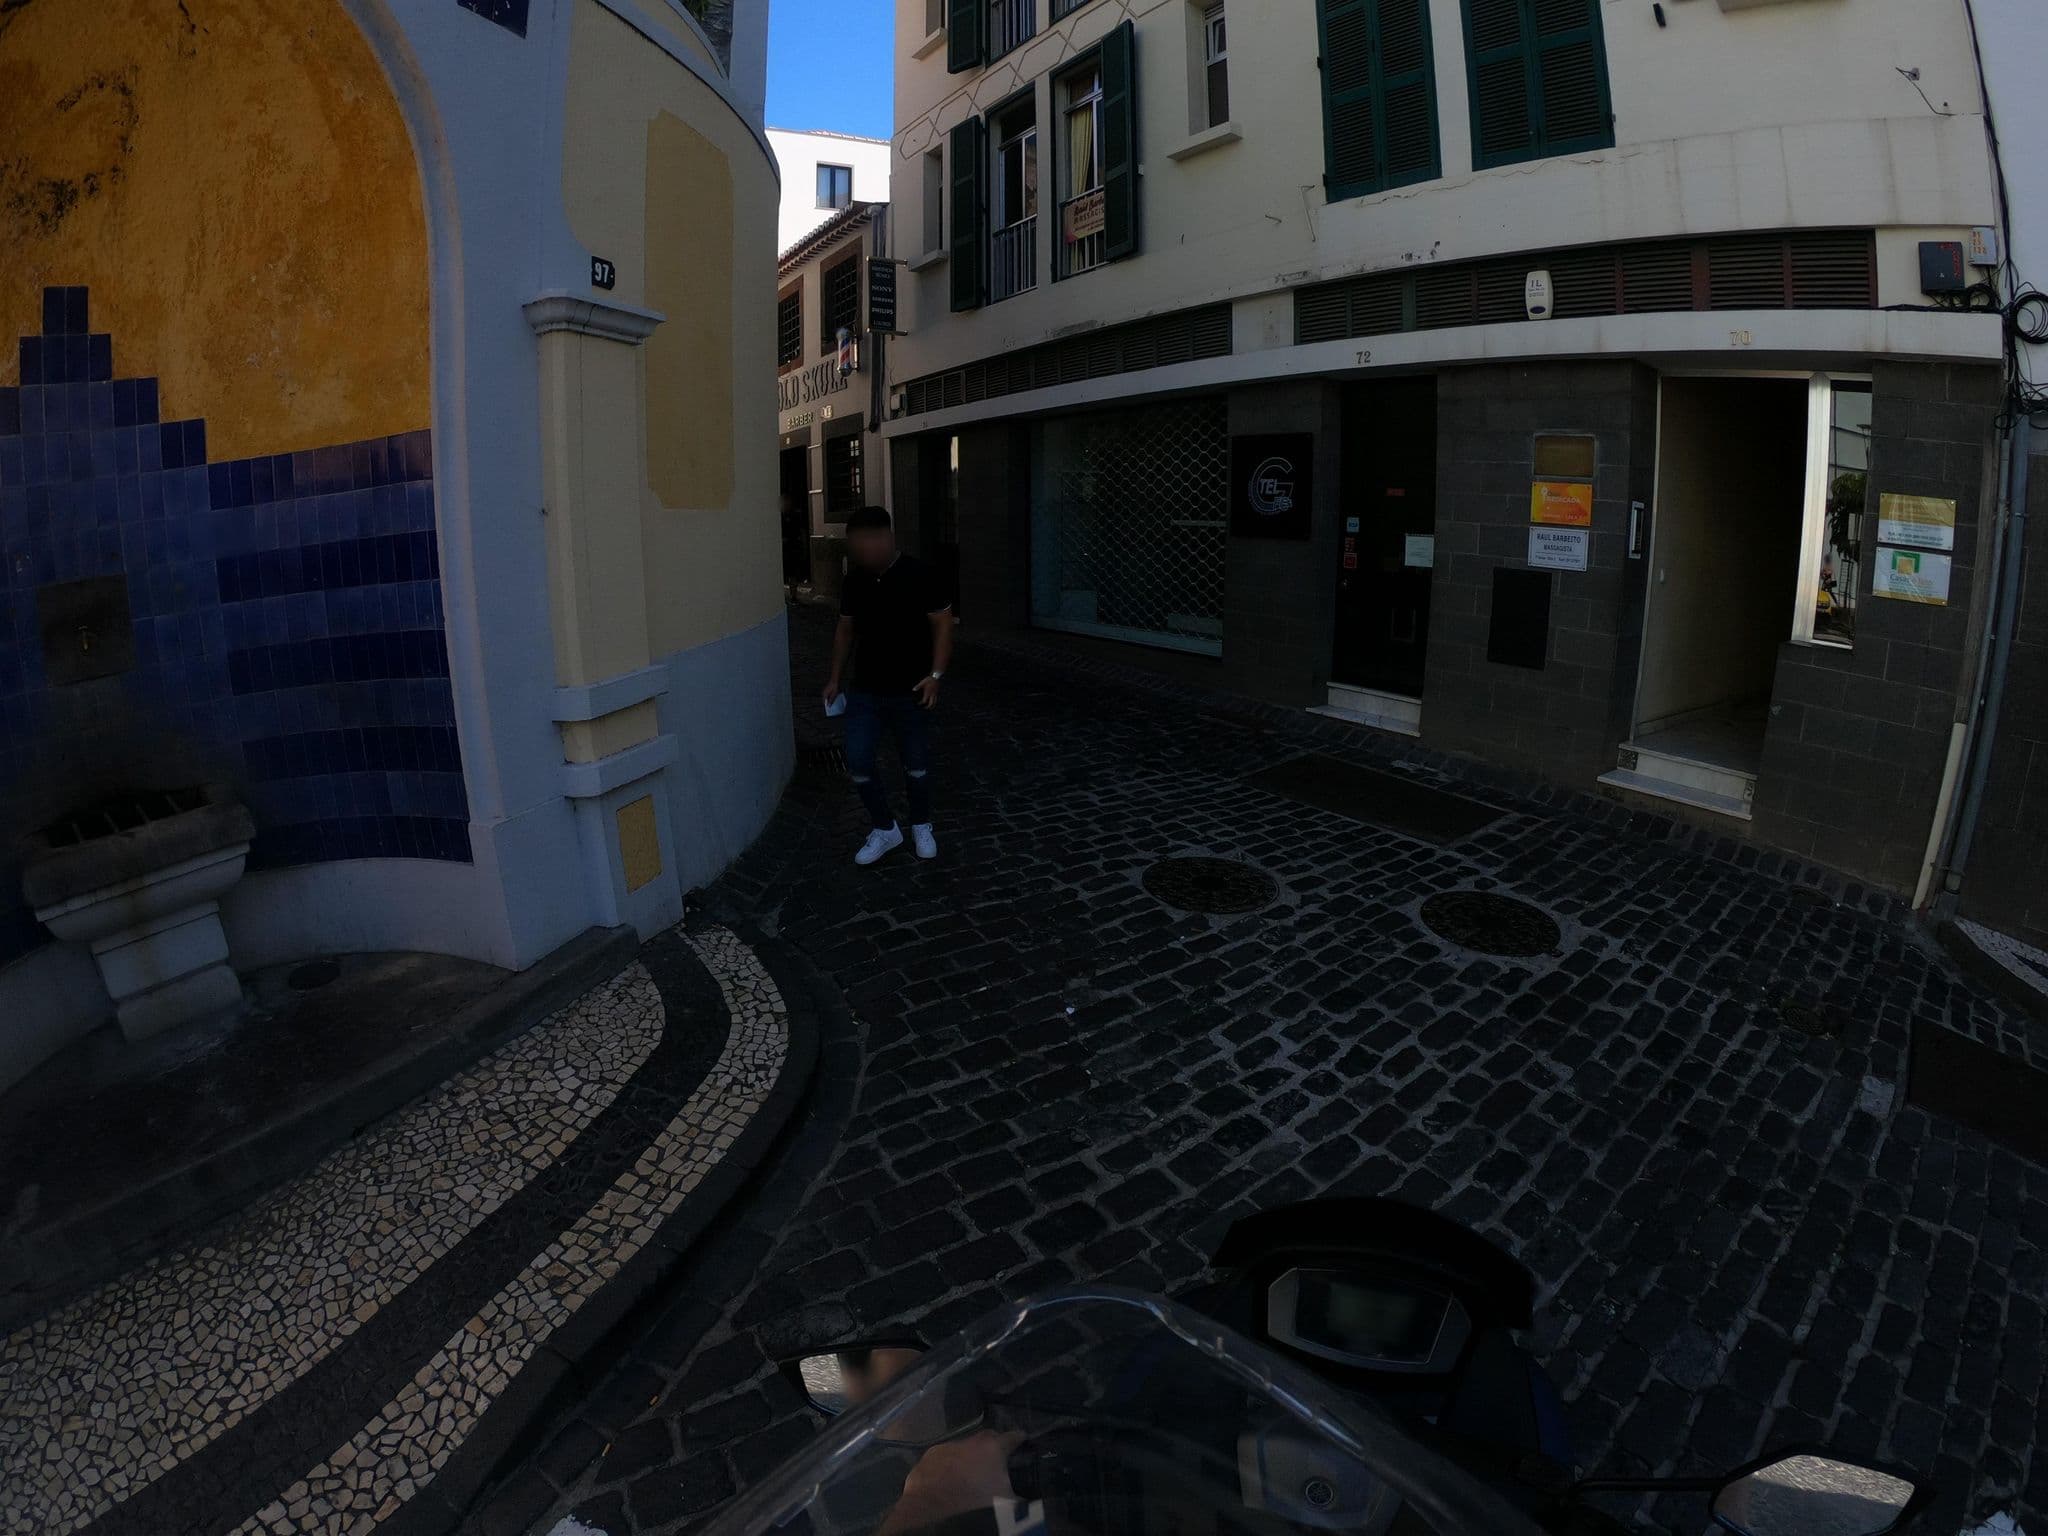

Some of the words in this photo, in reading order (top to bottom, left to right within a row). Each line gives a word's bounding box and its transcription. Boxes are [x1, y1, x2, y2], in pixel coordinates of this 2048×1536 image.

[594, 262, 609, 283] 97
[872, 285, 893, 293] SONY
[872, 307, 893, 315] PHILIPS
[1730, 328, 1752, 345] 70
[1356, 351, 1371, 364] 72
[787, 412, 814, 429] BARBER
[1552, 534, 1582, 543] BARBEITO
